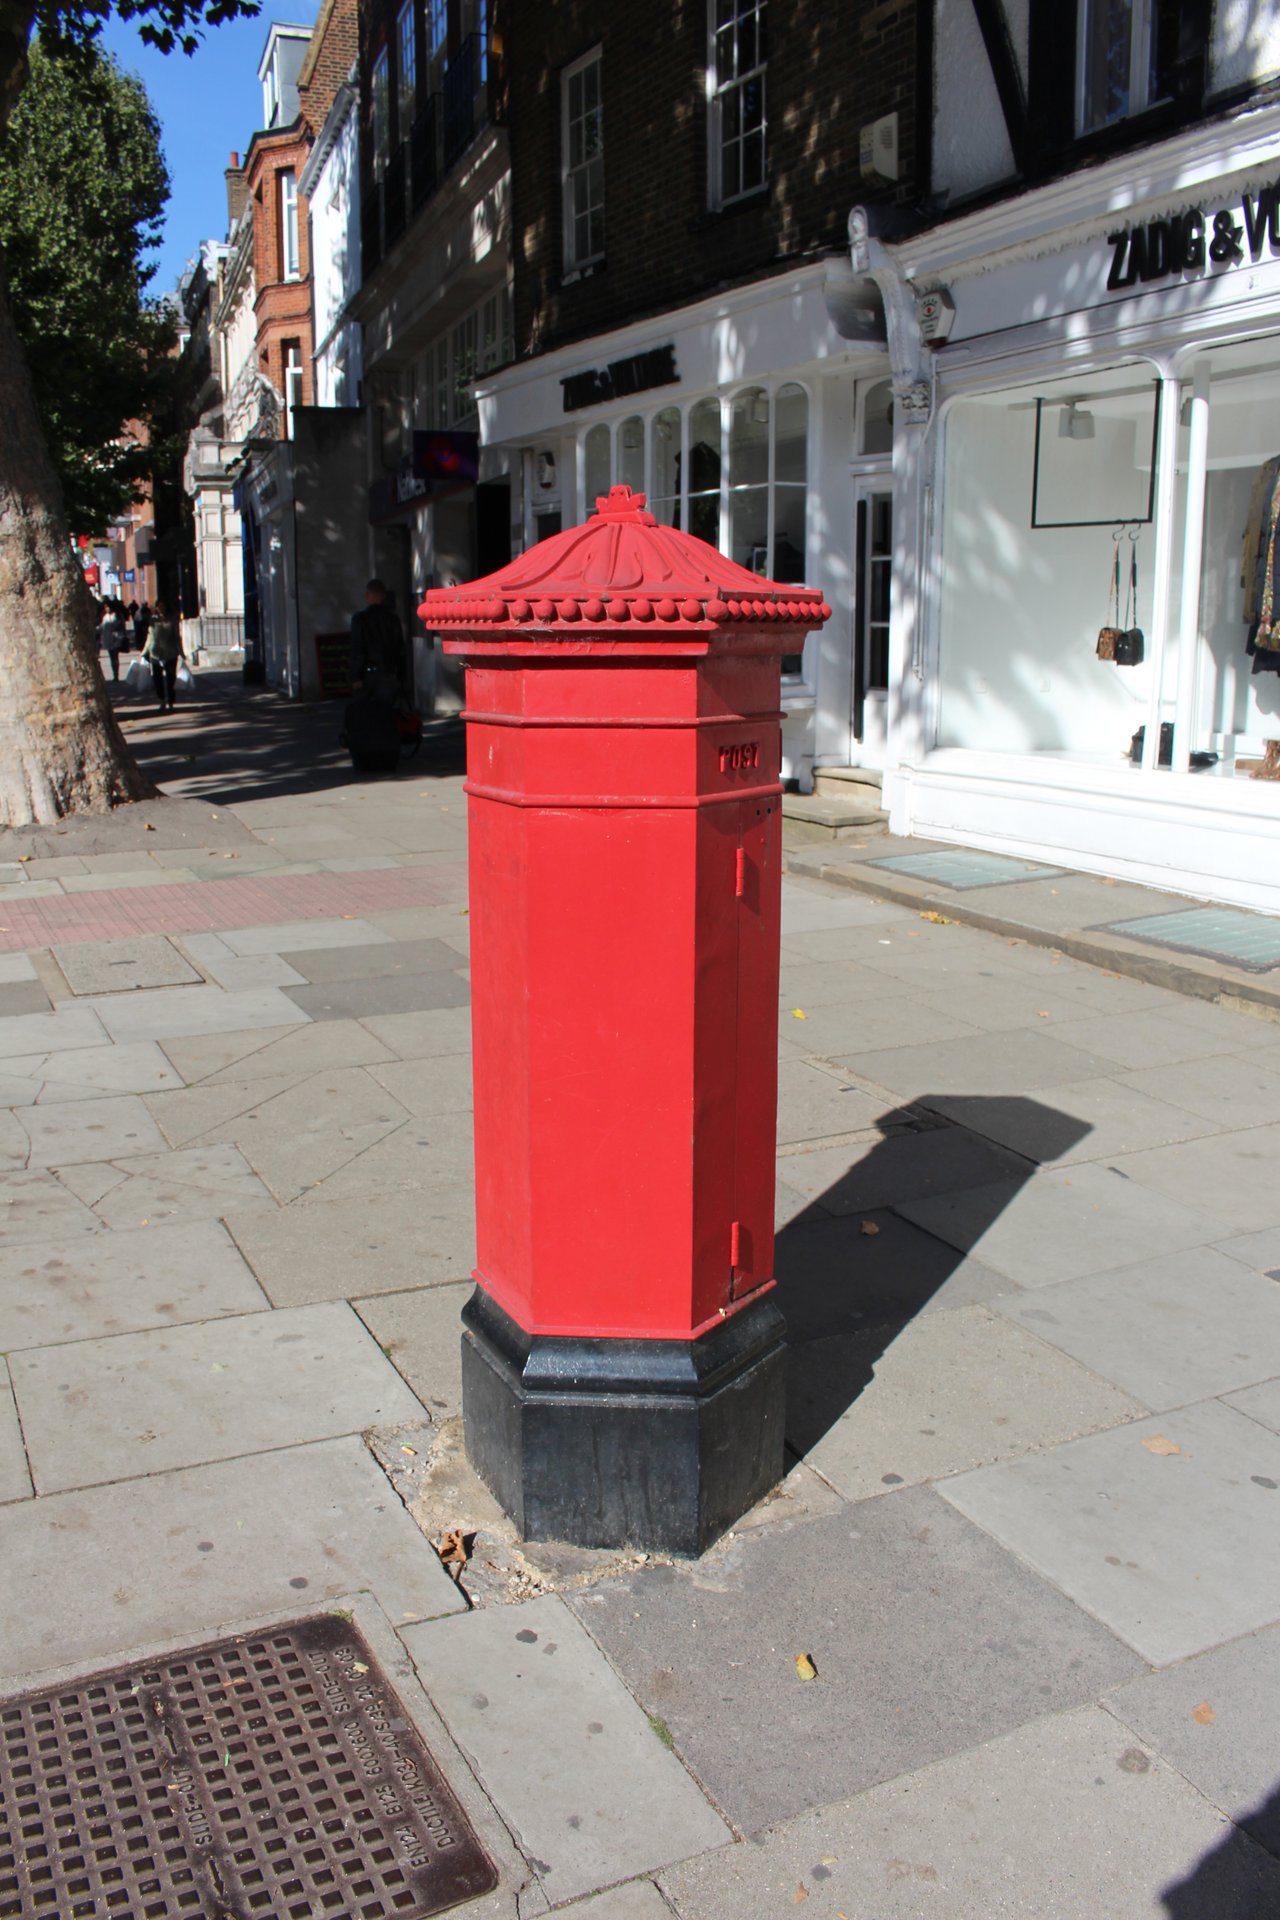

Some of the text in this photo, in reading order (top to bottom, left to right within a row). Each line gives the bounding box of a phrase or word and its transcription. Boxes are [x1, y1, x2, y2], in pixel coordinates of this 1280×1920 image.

[1107, 209, 1206, 291] ZADIG
[1209, 209, 1245, 262] &
[718, 741, 760, 773] POST
[308, 1651, 430, 1868] EN124 B125 600X600 SLIDE-OUT
[172, 1768, 213, 1845] SLIDE-OUT
[413, 1794, 456, 1849] DUCTILE
